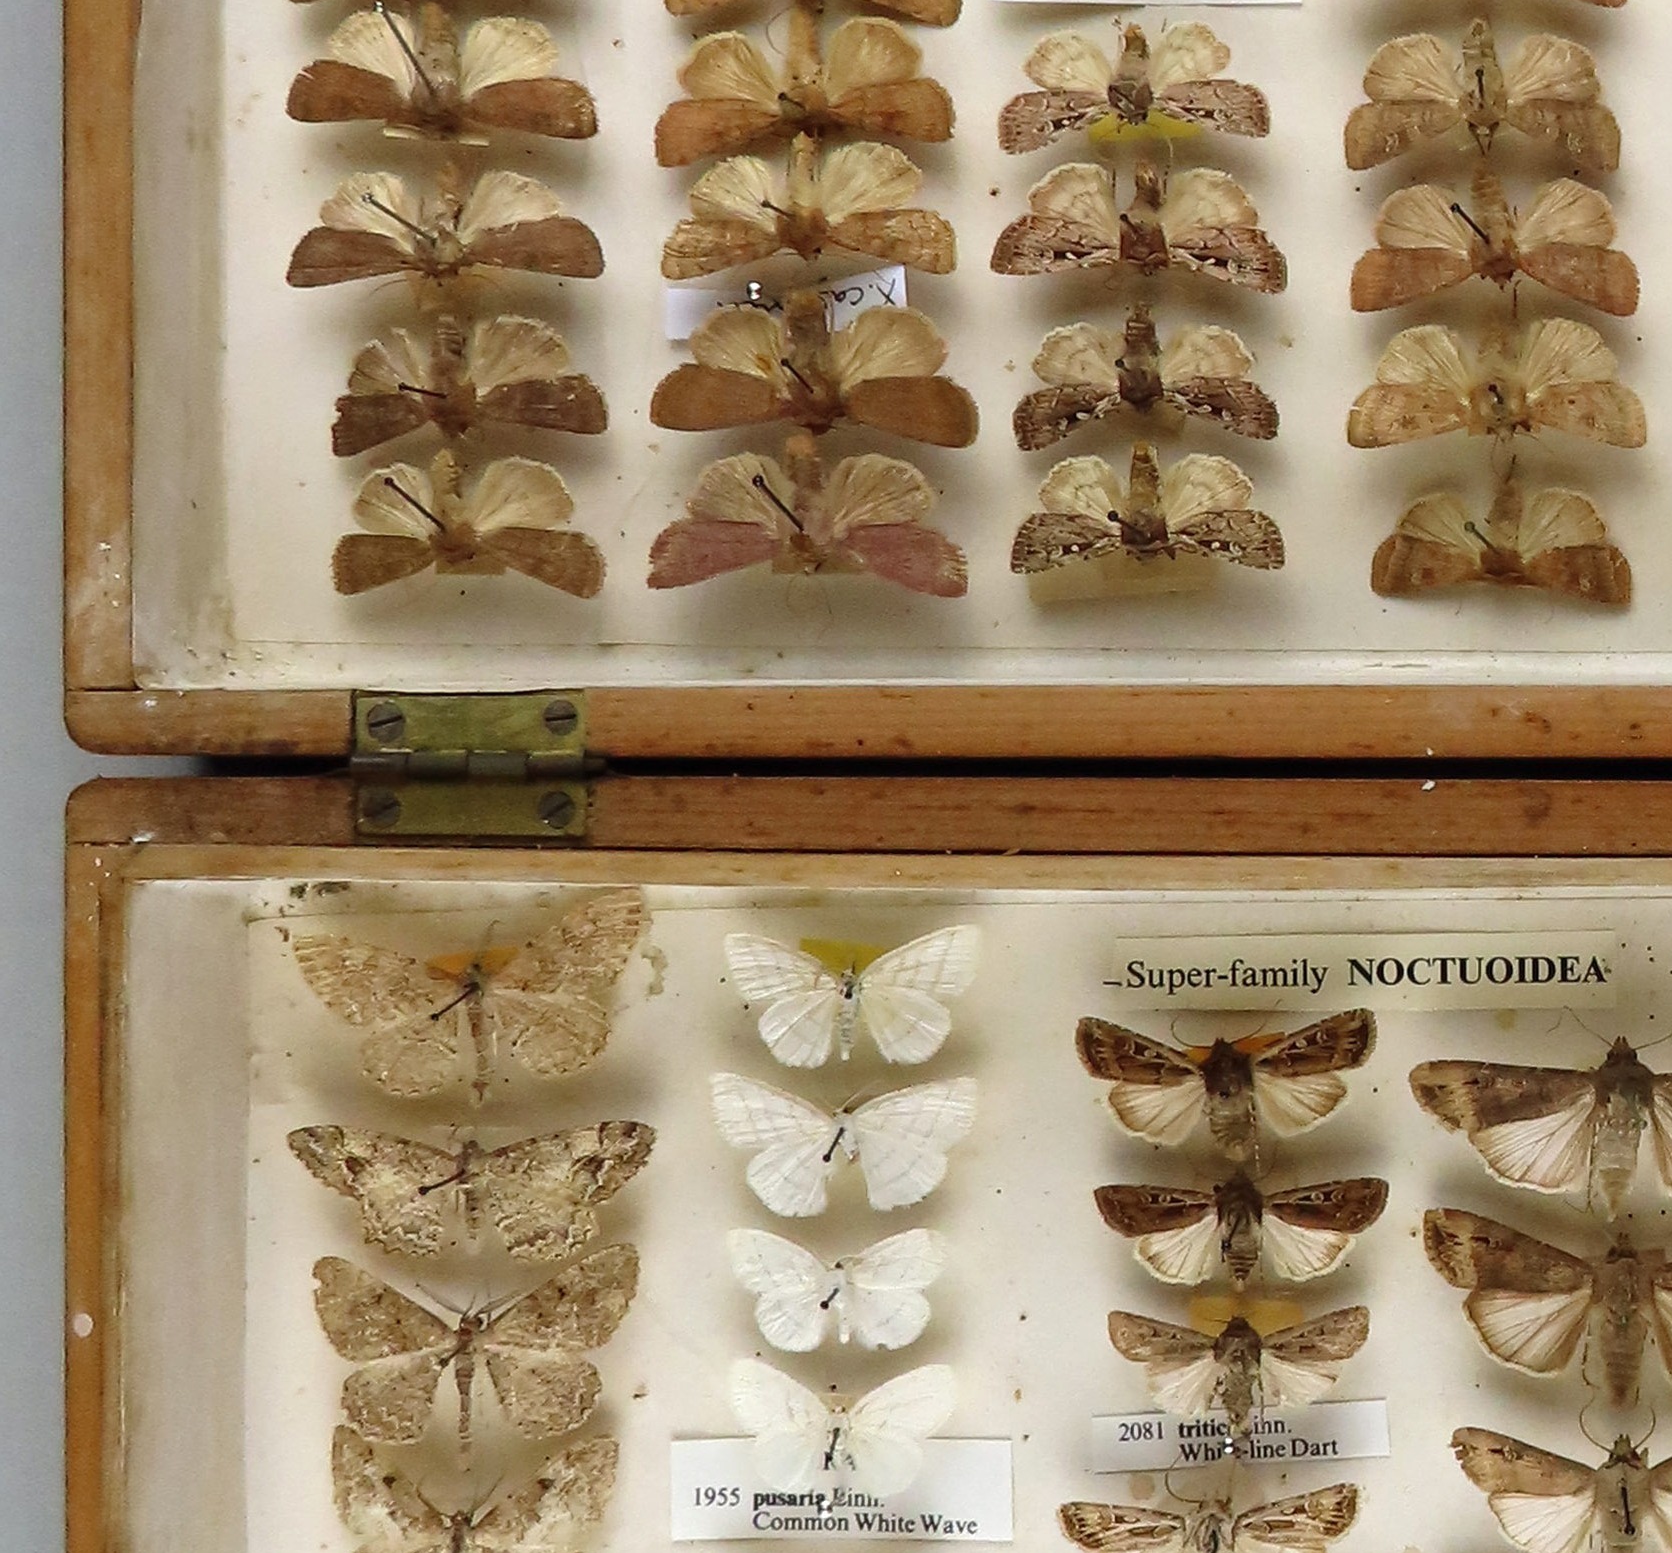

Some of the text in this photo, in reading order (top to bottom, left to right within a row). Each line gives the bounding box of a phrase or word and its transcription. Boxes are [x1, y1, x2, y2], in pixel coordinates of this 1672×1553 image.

[1126, 957, 1608, 995] Super-family NOCTUOIDEA
[1119, 1423, 1163, 1441] 2081
[1292, 1439, 1338, 1456] Dart
[694, 1488, 740, 1507] 1955
[753, 1512, 978, 1534] Common White Wave
